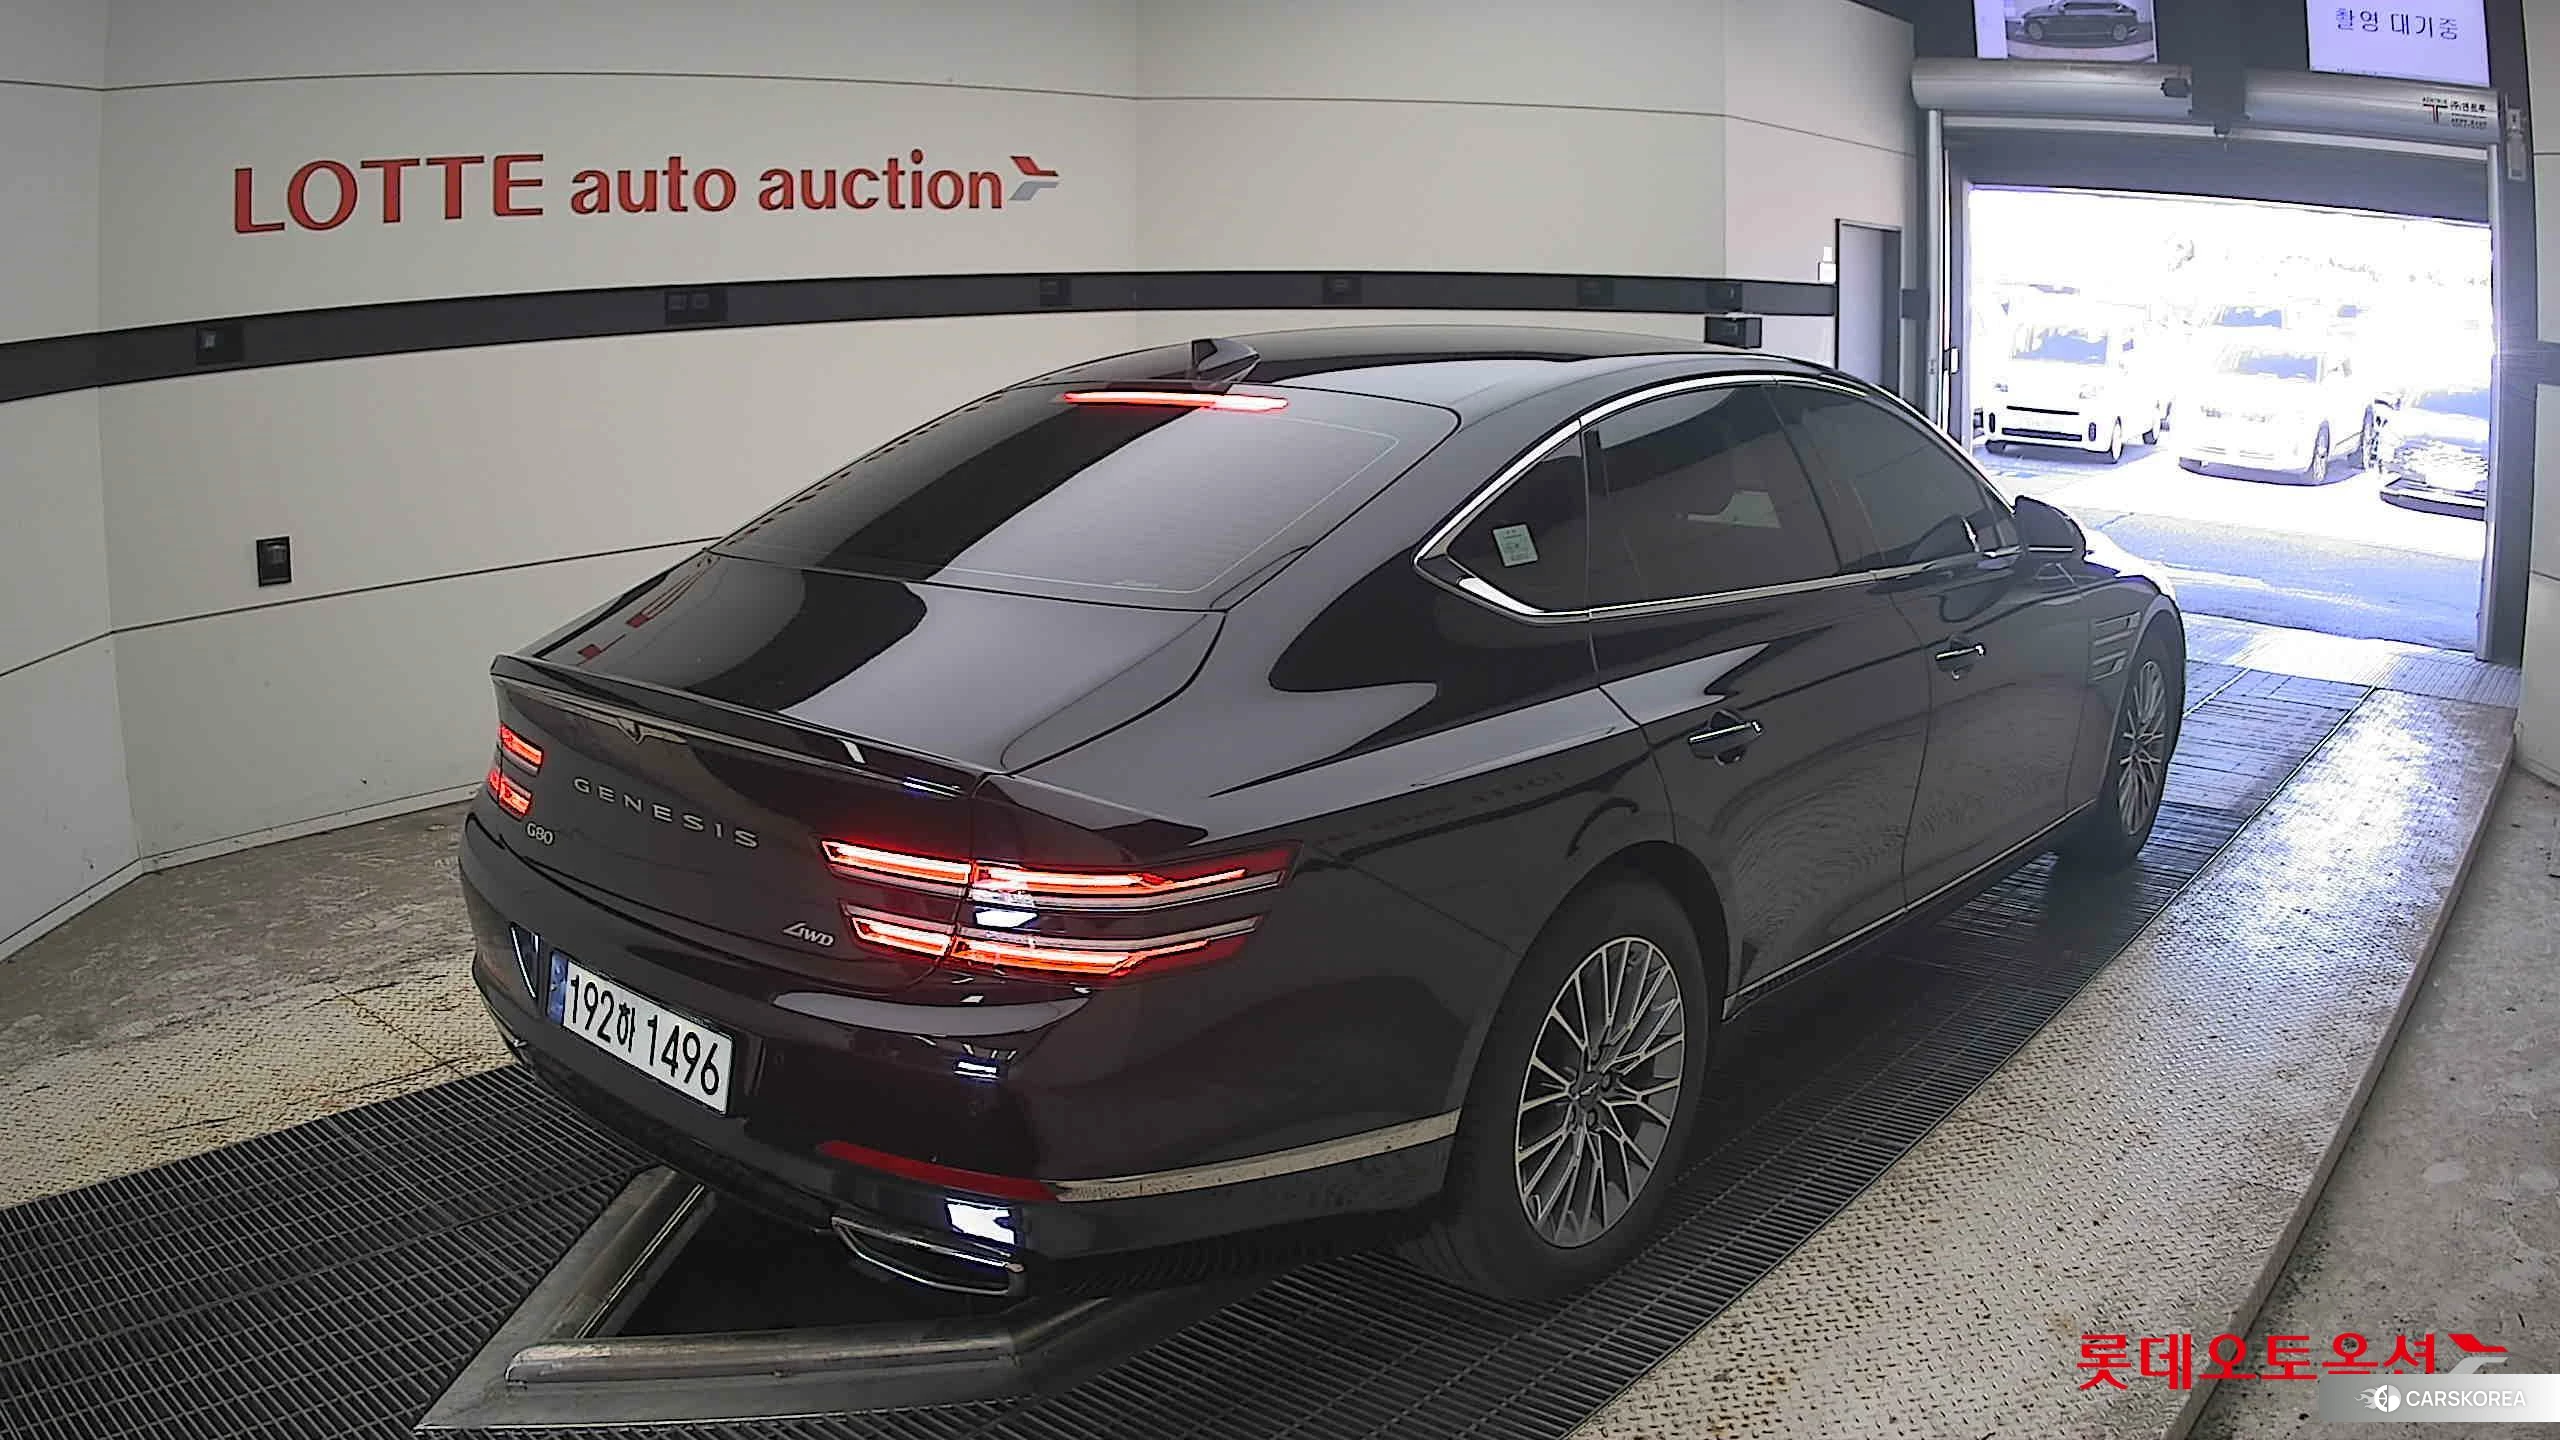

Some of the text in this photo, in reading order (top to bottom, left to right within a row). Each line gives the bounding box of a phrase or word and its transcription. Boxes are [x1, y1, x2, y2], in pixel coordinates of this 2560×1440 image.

[2390, 13, 2458, 40] 대기중
[234, 149, 1003, 234] LOTTE auto auction
[526, 822, 554, 846] G80
[573, 777, 760, 849] GENESIS
[783, 922, 834, 947] 4WD
[570, 974, 720, 1096] 192하 1496
